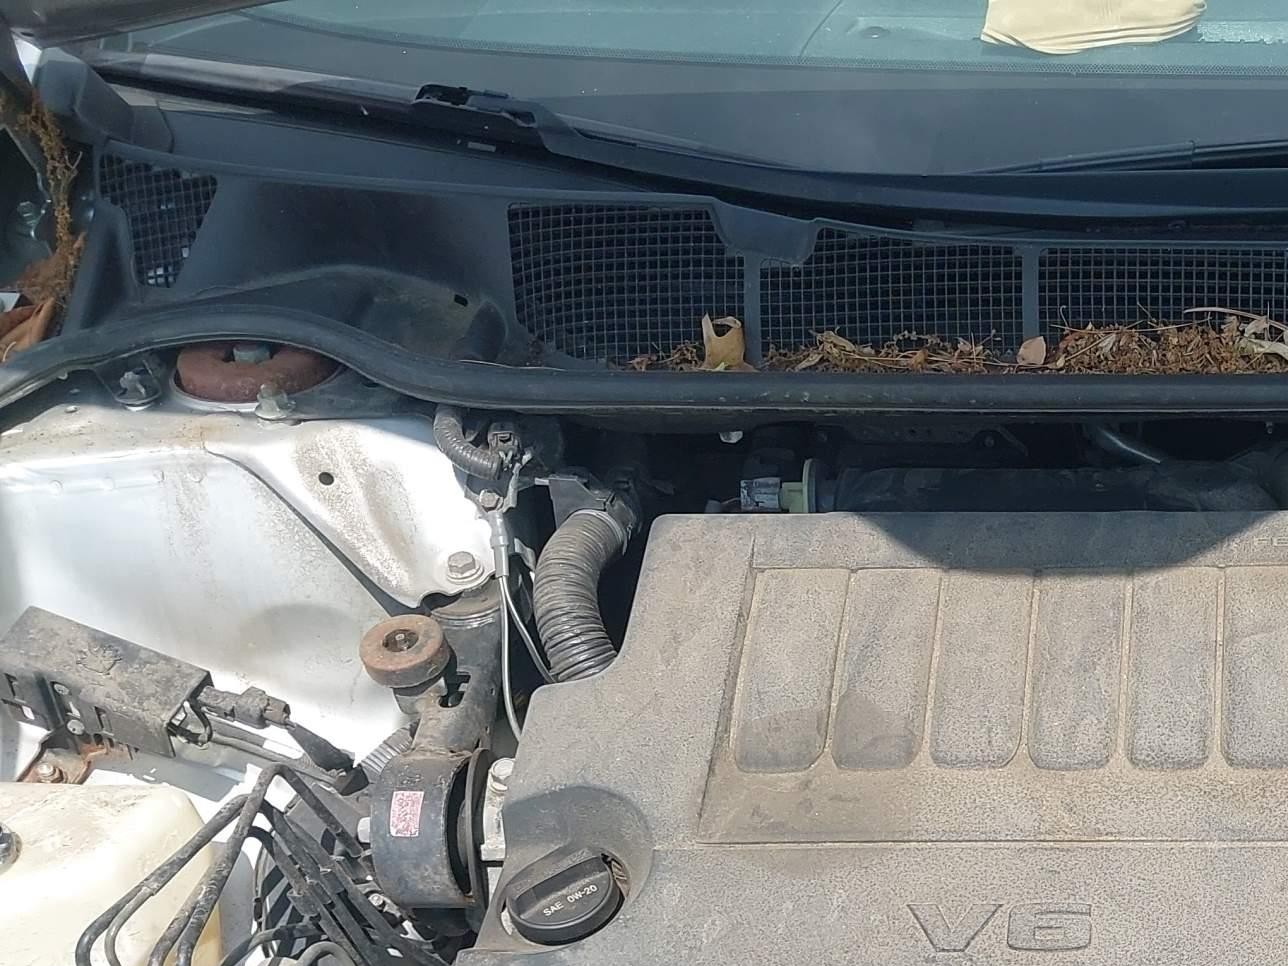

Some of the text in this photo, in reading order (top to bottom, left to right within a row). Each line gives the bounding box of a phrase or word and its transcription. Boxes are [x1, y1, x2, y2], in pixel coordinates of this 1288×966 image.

[543, 884, 598, 916] SAE 0W-20
[905, 903, 1092, 952] V6
